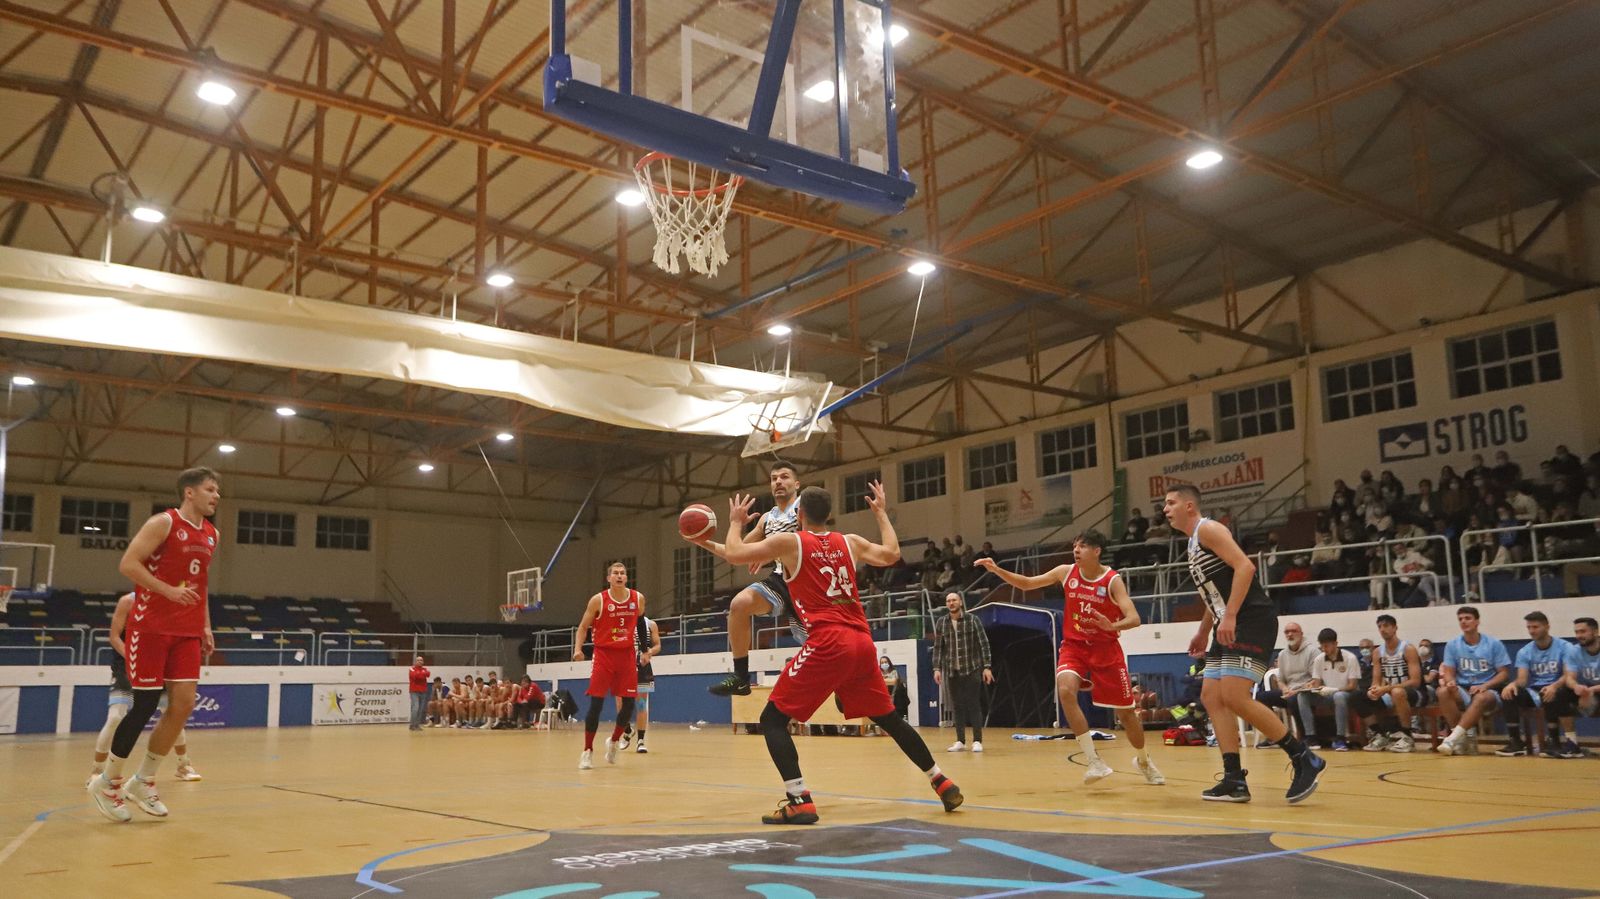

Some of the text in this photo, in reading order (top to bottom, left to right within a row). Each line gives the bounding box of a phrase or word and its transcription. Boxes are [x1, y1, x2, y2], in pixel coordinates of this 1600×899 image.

[1434, 404, 1528, 455] STROG
[1163, 452, 1246, 475] SUPERMERCADOS
[189, 558, 201, 575] 6
[820, 566, 854, 597] 24
[1079, 601, 1092, 614] 14
[619, 617, 625, 627] 3
[1239, 656, 1252, 668] 15
[354, 687, 402, 696] Gimnasio
[353, 697, 386, 706] Forma
[353, 707, 391, 716] Fitness
